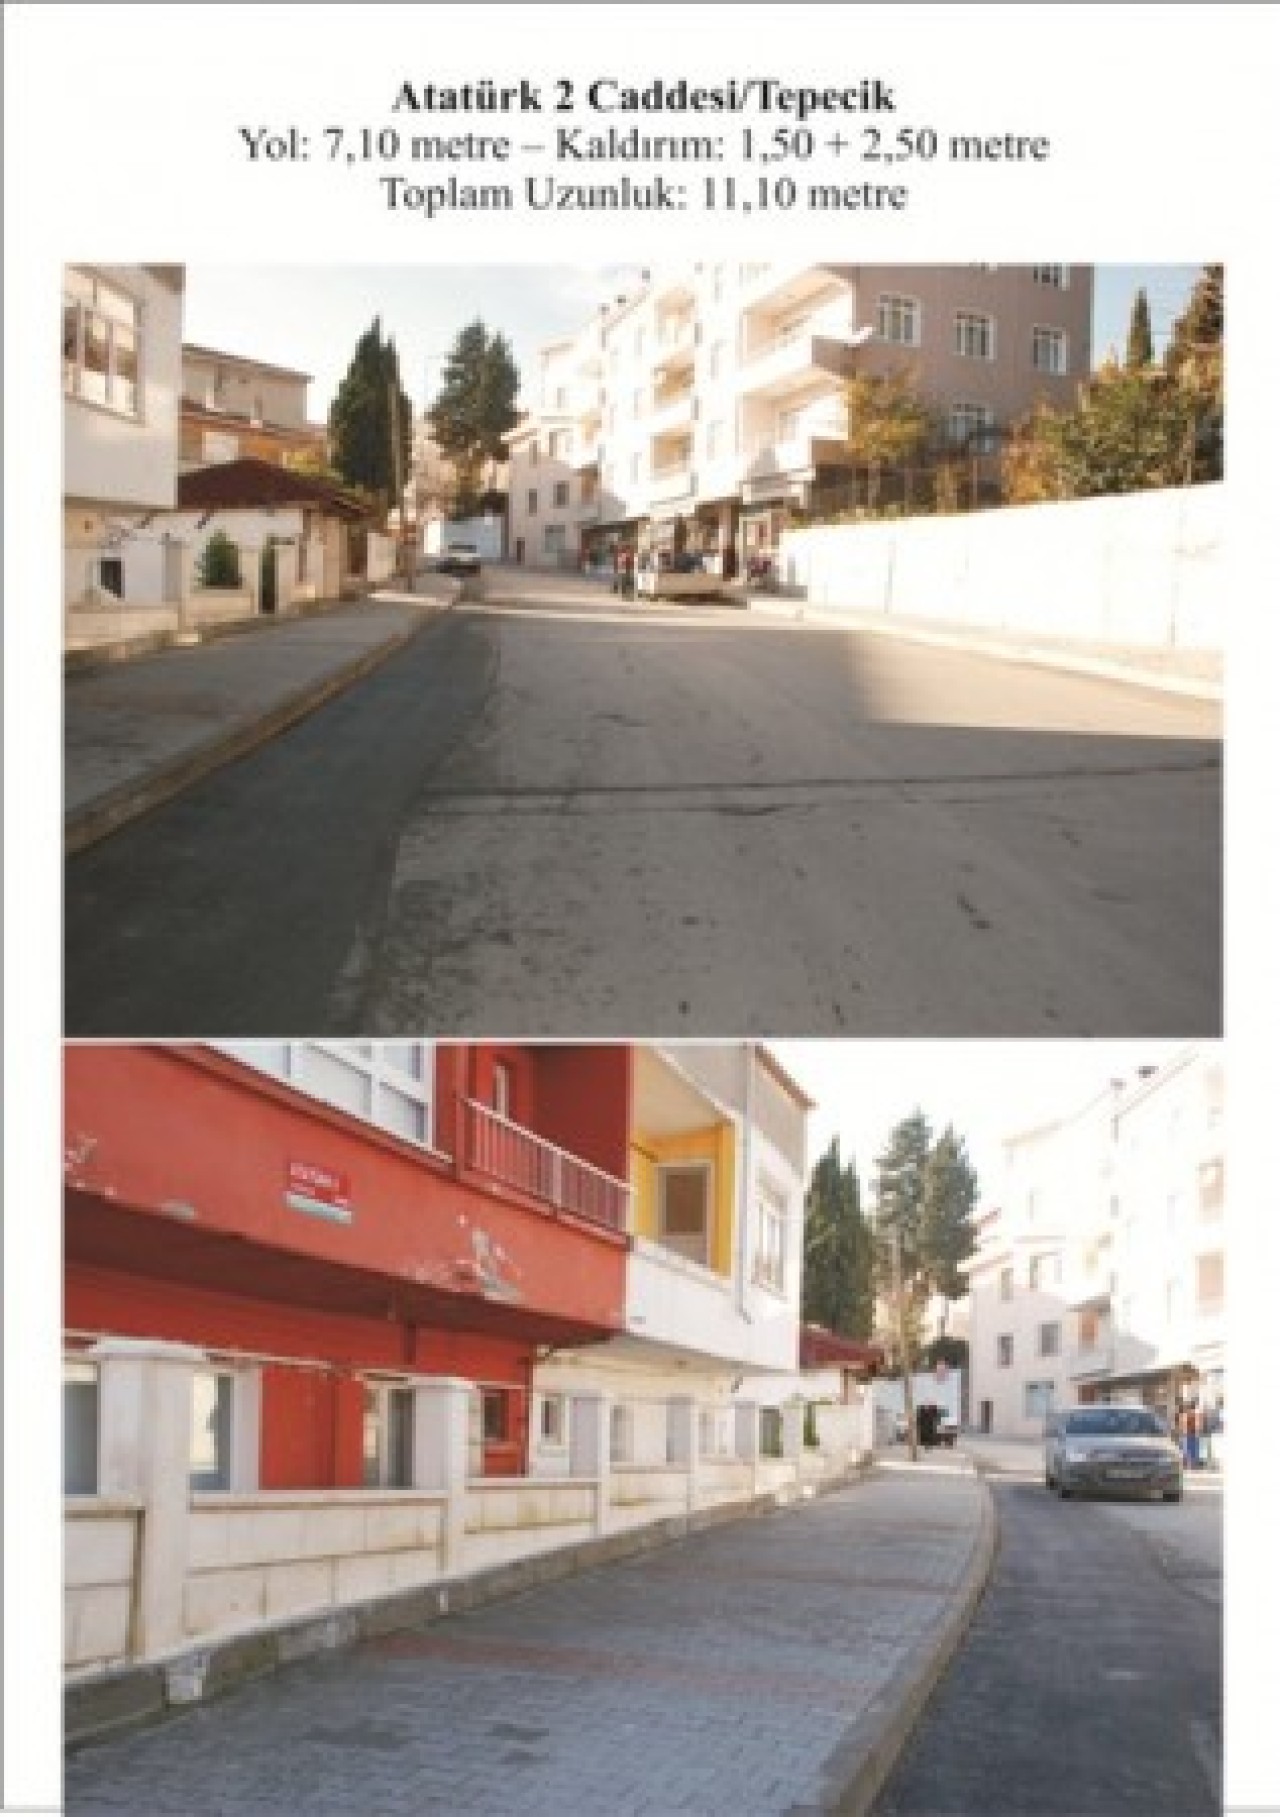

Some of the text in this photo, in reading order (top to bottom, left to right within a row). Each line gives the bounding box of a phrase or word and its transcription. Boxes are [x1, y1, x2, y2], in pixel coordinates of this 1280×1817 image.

[392, 79, 896, 121] Atatürk 2 Caddesi/Tepecik
[238, 128, 308, 159] Yol:
[323, 128, 400, 164] 7,10
[411, 132, 510, 159] metre
[555, 128, 724, 159] Kaldırım:
[742, 128, 813, 164] 1,50
[862, 128, 938, 164] 2,50
[950, 132, 1050, 159] metre
[379, 176, 908, 218] Toplam Uzunluk: 11,10 metre
